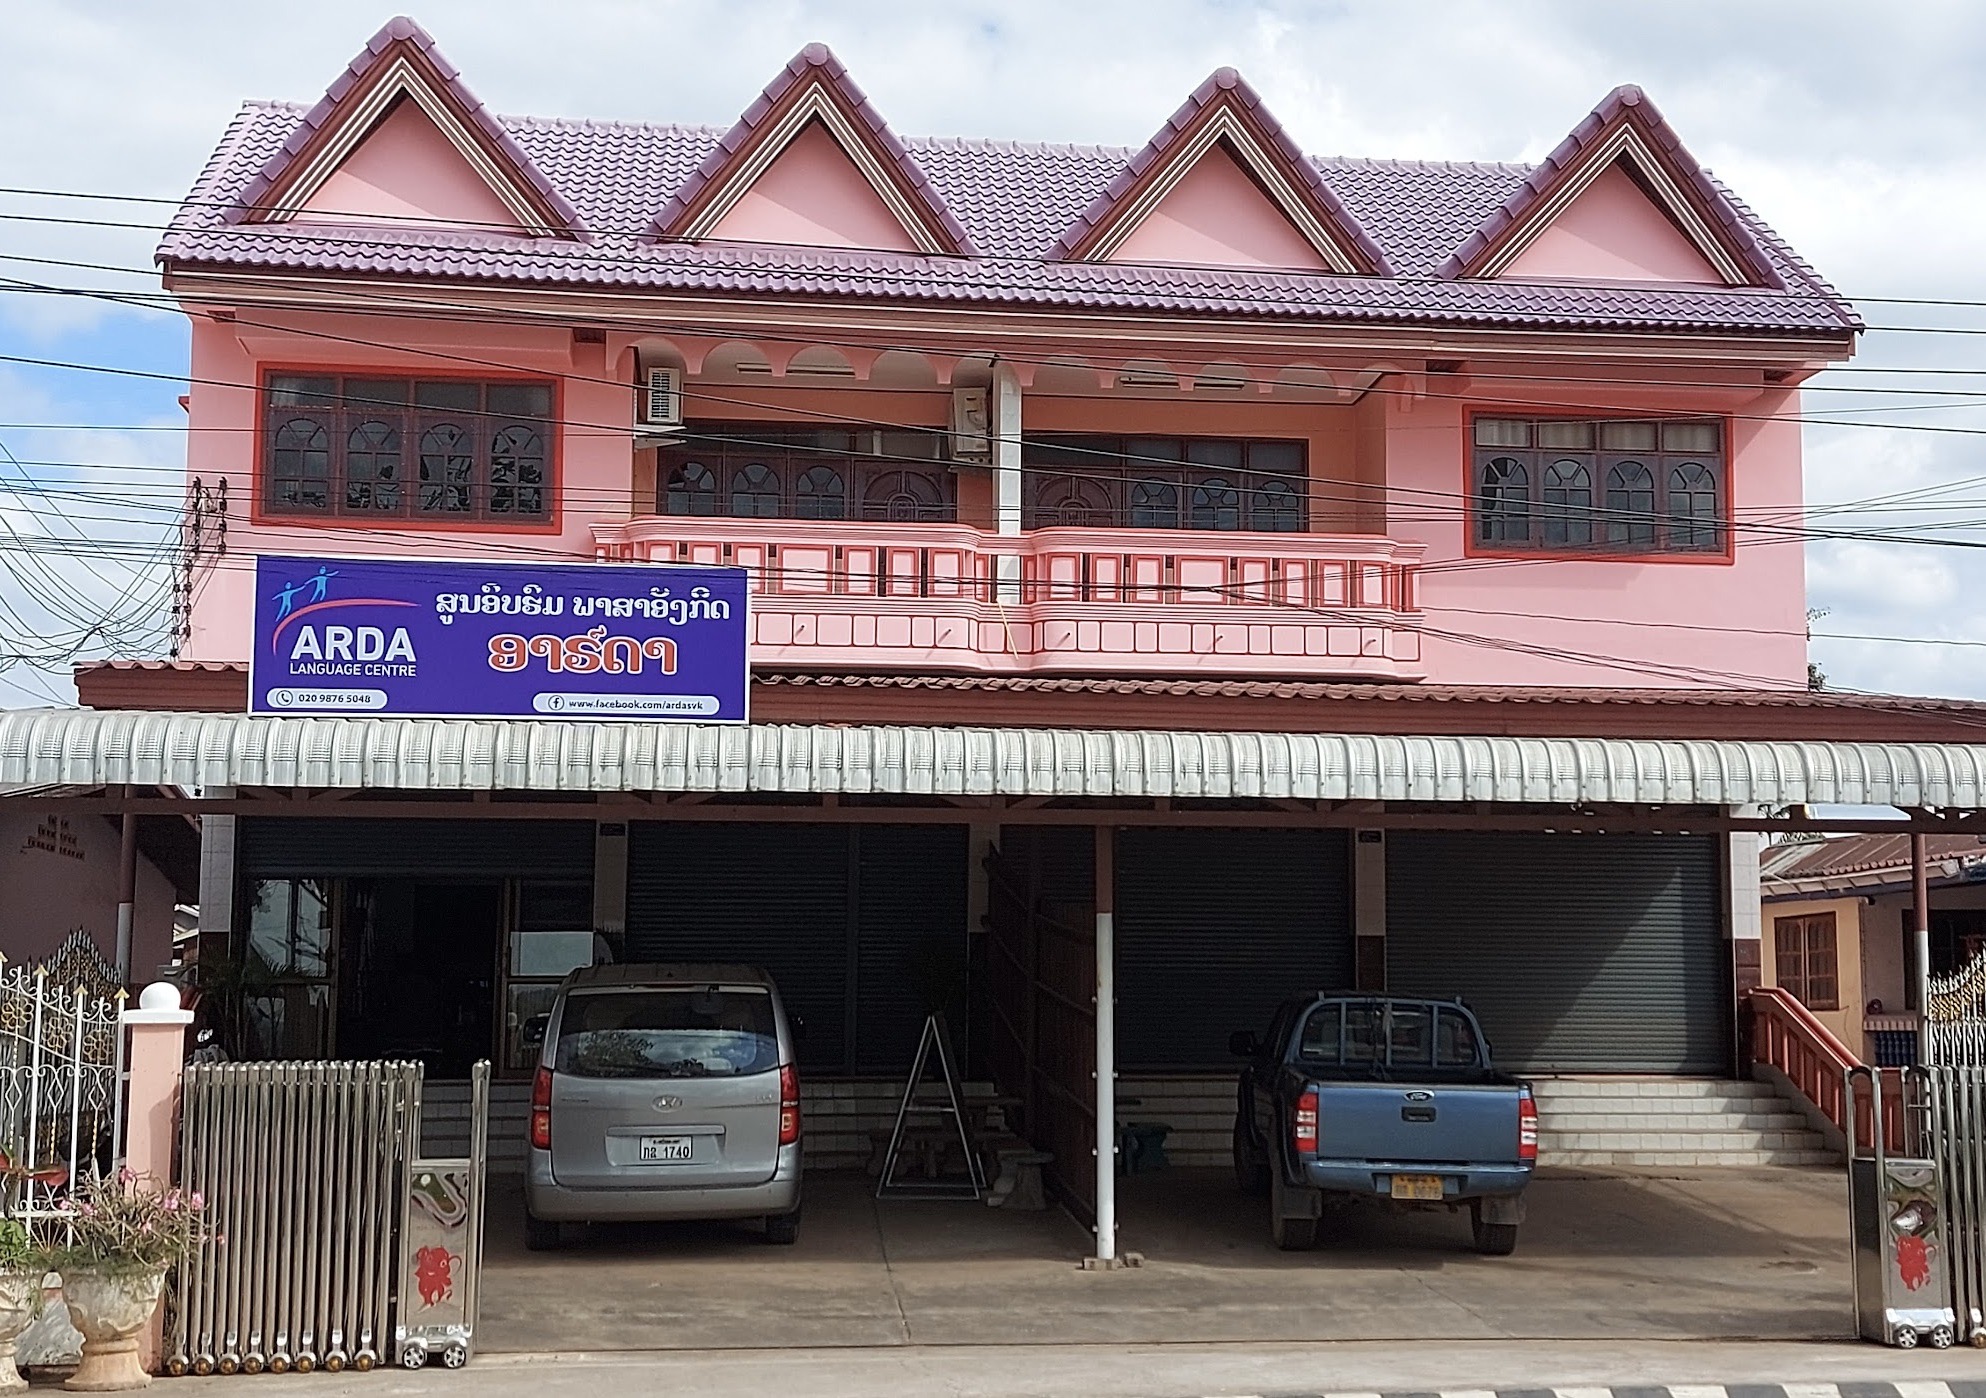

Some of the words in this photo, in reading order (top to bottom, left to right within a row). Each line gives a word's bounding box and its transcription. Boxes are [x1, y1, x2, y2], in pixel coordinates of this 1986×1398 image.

[290, 625, 416, 662] ARDA
[289, 662, 362, 676] LANGUAGE
[364, 664, 417, 677] CENTRE
[298, 694, 317, 703] 020
[319, 694, 344, 703] 9876
[346, 695, 371, 704] 5048
[568, 699, 704, 710] www.facebook.com/ardasvk
[664, 1146, 690, 1158] 1740
